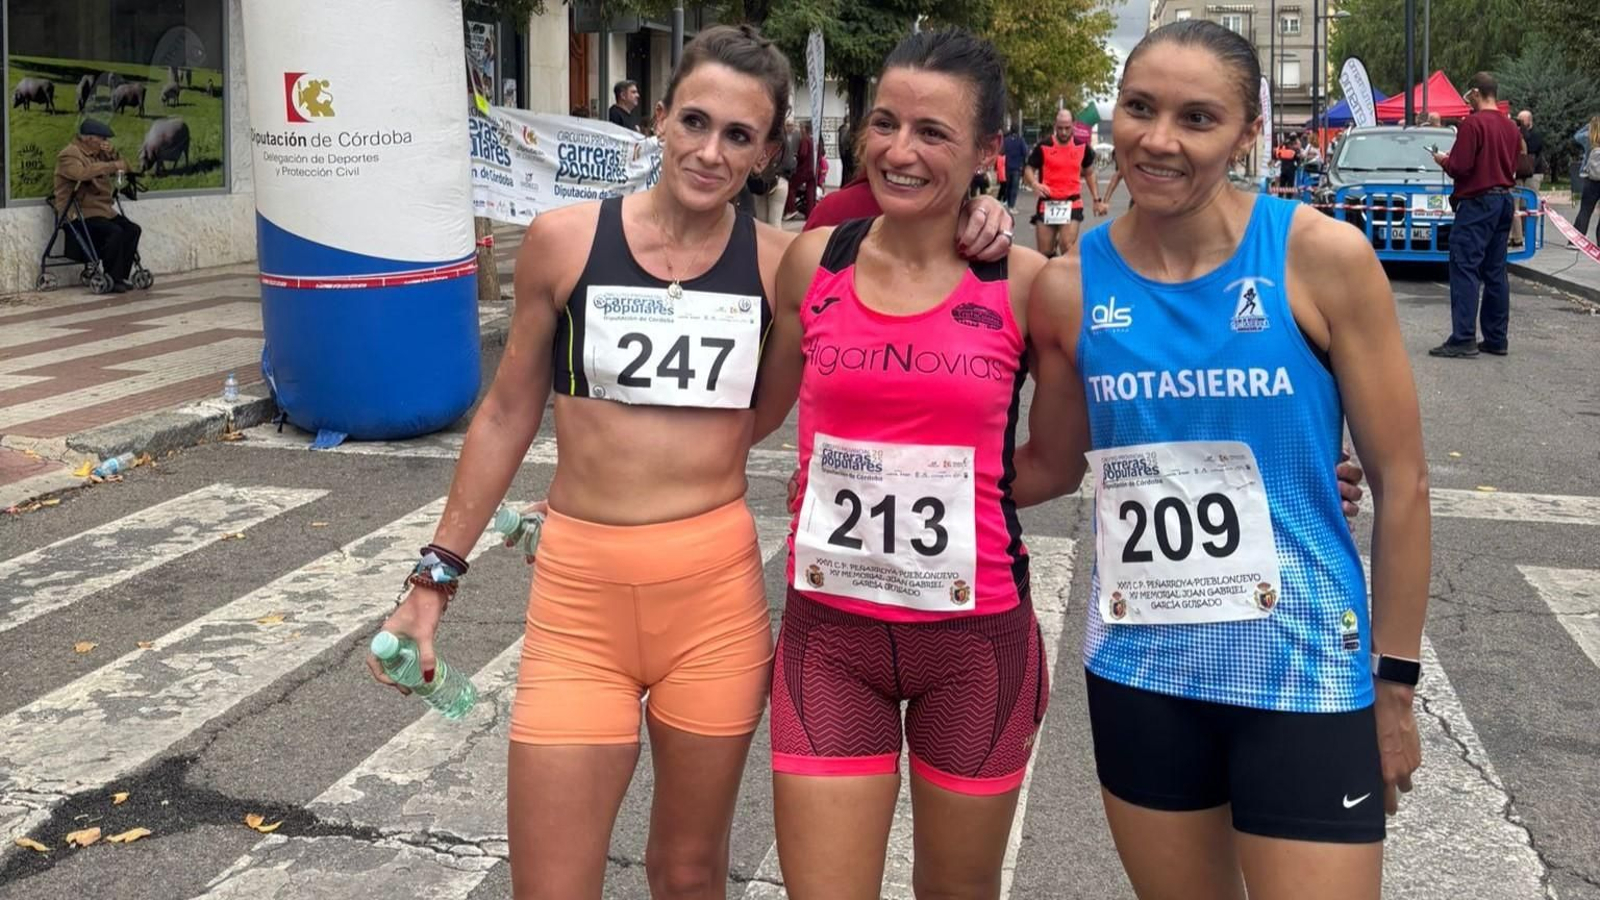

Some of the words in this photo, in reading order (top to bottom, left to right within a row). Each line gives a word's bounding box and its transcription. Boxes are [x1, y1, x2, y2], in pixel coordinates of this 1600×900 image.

[310, 133, 332, 148] de
[338, 130, 413, 148] Córdoba
[263, 151, 308, 164] Delegación
[310, 152, 325, 164] de
[327, 153, 379, 165] Deportes
[557, 142, 620, 166] carreras
[275, 166, 281, 177] y
[282, 167, 332, 177] Protección
[335, 166, 360, 177] Civil
[555, 159, 628, 184] populares
[554, 184, 597, 199] Diputación
[1050, 206, 1068, 217] 177
[604, 304, 674, 316] populares
[617, 332, 735, 391] 247
[1089, 366, 1294, 403] TROTASIERRA
[822, 448, 871, 464] carreras
[821, 457, 883, 473] populares
[1103, 458, 1147, 471] carreras
[827, 488, 949, 557] 213
[1119, 492, 1240, 563] 209
[908, 579, 944, 589] GABRIEL
[1140, 590, 1181, 600] MEMORIAL
[1182, 589, 1206, 598] JUAN
[1207, 586, 1247, 597] GABRIEL
[1182, 598, 1222, 608] GUISADO
